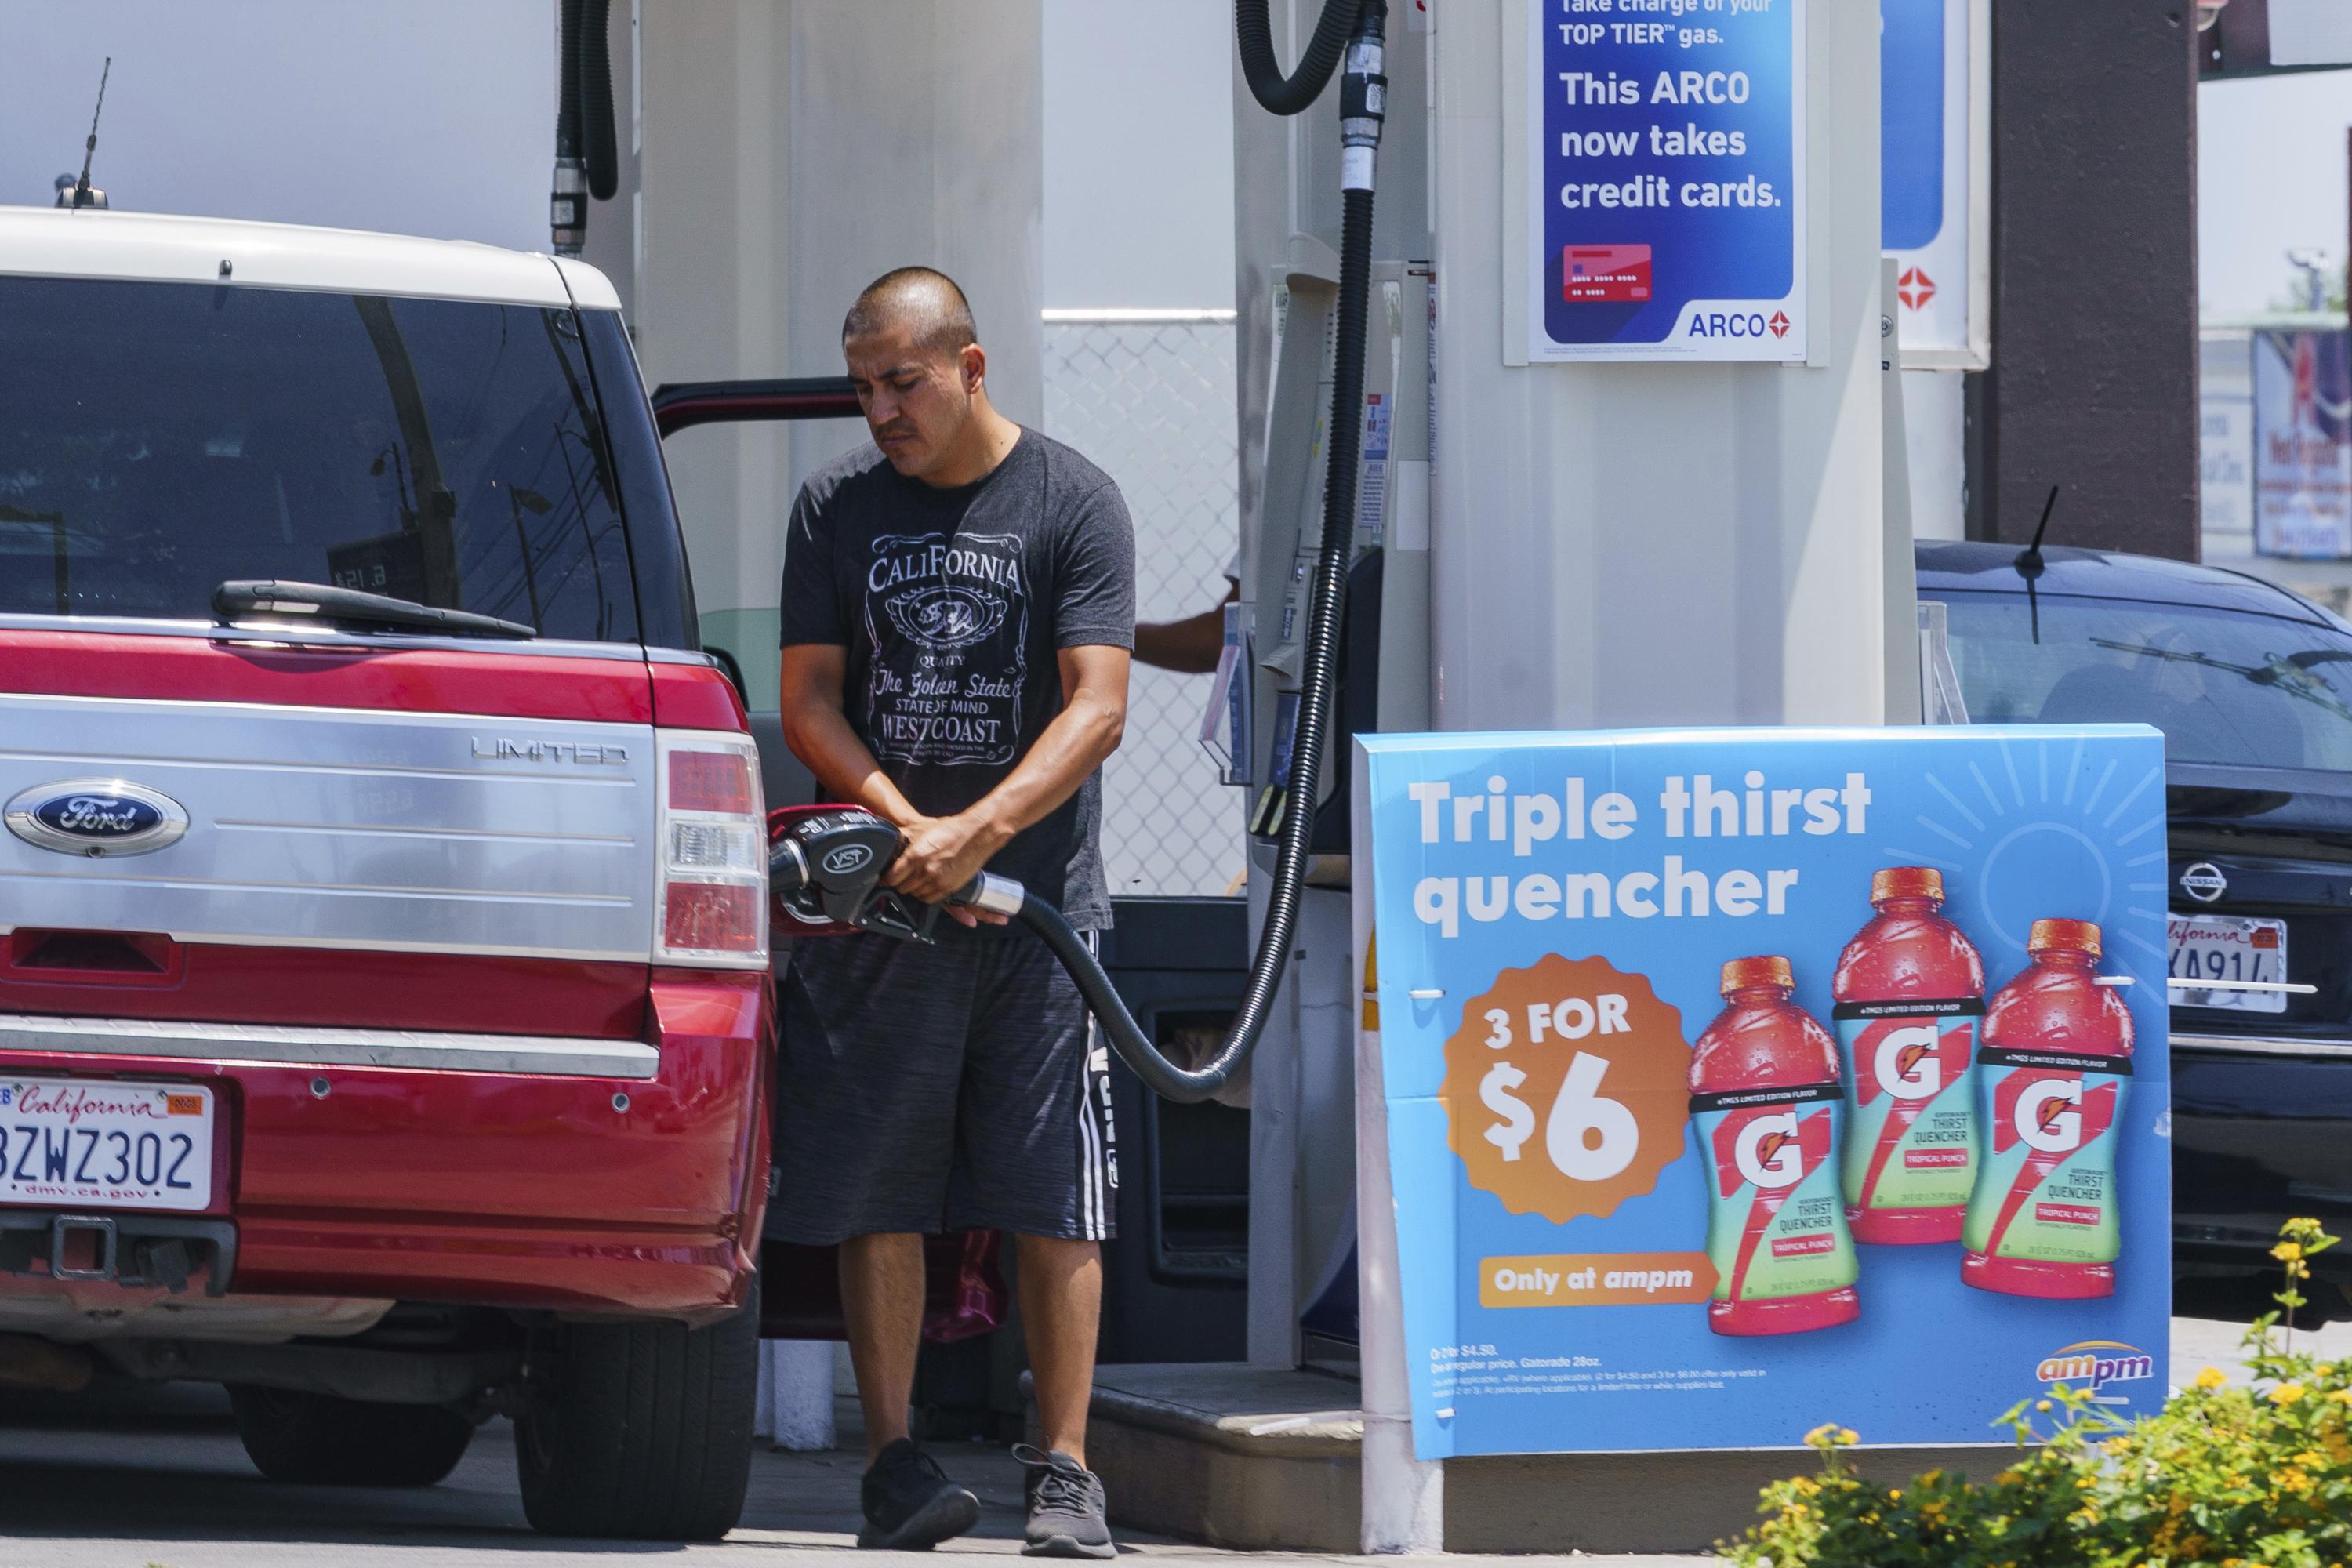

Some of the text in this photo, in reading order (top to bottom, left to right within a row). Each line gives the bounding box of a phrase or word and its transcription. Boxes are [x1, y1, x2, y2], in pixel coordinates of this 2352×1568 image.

[1559, 24, 1606, 45] TOP
[1679, 27, 1725, 49] gas.
[1559, 71, 1751, 106] This ARCO
[1560, 123, 1747, 157] now takes
[1560, 174, 1782, 209] credit cards.
[1688, 313, 1765, 339] ARCO
[869, 544, 1023, 597] CALIFORNIA
[875, 669, 902, 696] The
[964, 673, 1011, 699] State
[895, 698, 934, 714] STATE
[949, 699, 989, 715] MIND
[471, 735, 630, 766] LIMITED
[59, 796, 139, 832] Ford
[1408, 770, 1872, 858] Triple thirst
[1413, 855, 1800, 939] quencher
[2183, 877, 2224, 887] NISSAN
[1483, 993, 1632, 1051] 3 FOR
[1874, 1025, 1942, 1100] G
[19, 1085, 168, 1125] California
[2014, 1079, 2082, 1152] G
[1914, 1131, 1969, 1145] QUENCHER
[1931, 1117, 1968, 1130] THIRST
[1734, 1112, 1803, 1189] G
[25, 1184, 149, 1200] dmv.ca.gov
[2048, 1185, 2103, 1200] QUENCHER
[2068, 1174, 2104, 1188] THIRST
[1780, 1216, 1834, 1234] QUENCHER
[1798, 1203, 1833, 1217] THIRST
[1494, 1267, 1694, 1295] Only at ampm
[1520, 1356, 1571, 1369] Gatorade
[2036, 1354, 2154, 1390] ampm
